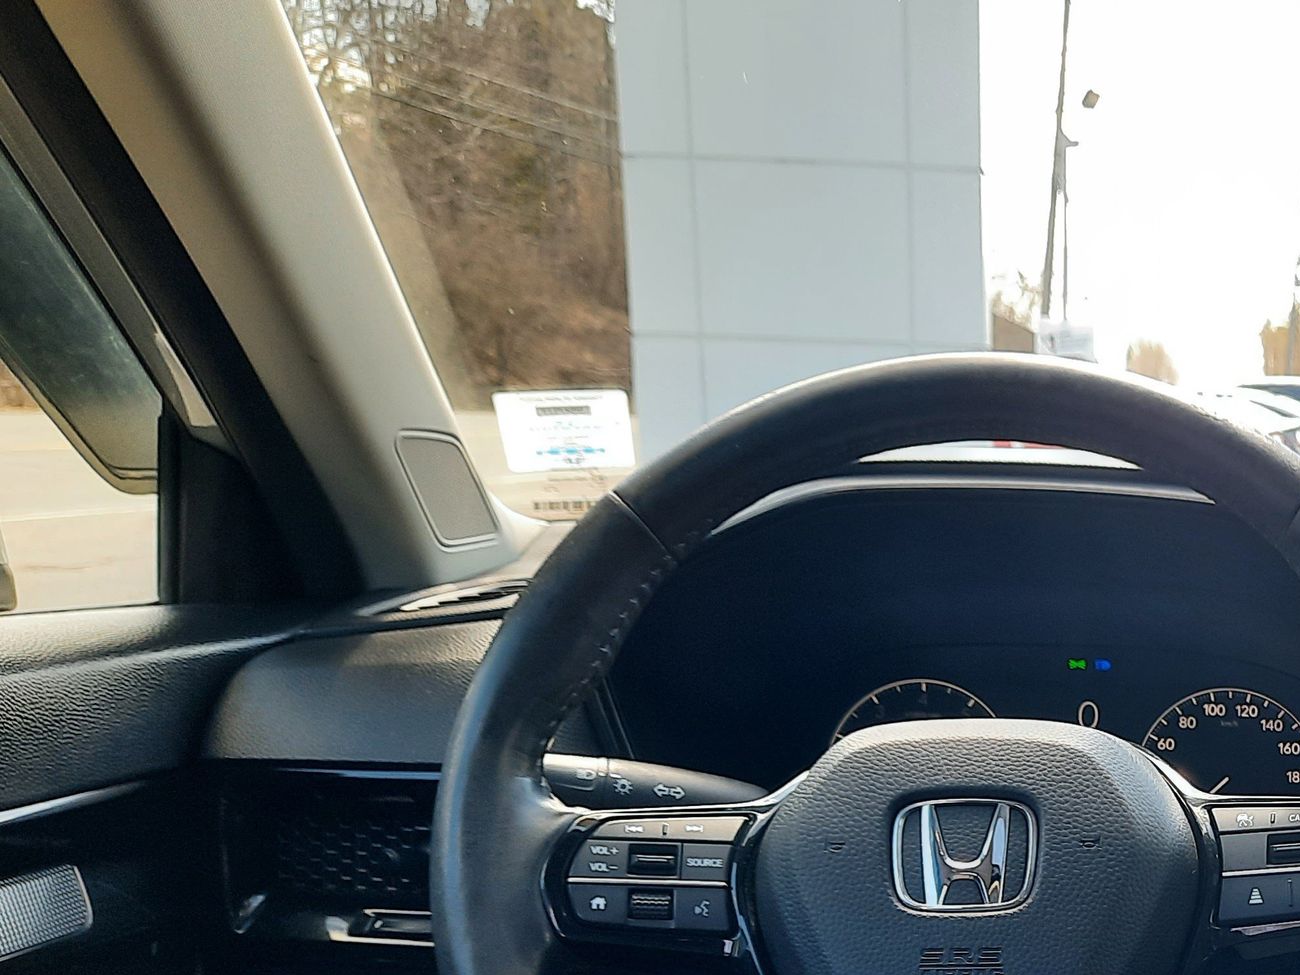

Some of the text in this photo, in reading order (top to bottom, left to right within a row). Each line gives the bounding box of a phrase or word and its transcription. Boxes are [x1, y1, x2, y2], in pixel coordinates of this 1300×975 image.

[1203, 704, 1225, 716] 100
[1235, 705, 1258, 718] 120
[1178, 716, 1197, 729] 80
[1260, 719, 1283, 732] 140
[1157, 738, 1175, 751] 60
[1278, 743, 1300, 755] 160
[686, 858, 724, 868] SOURCE
[920, 947, 1003, 965] SRS
